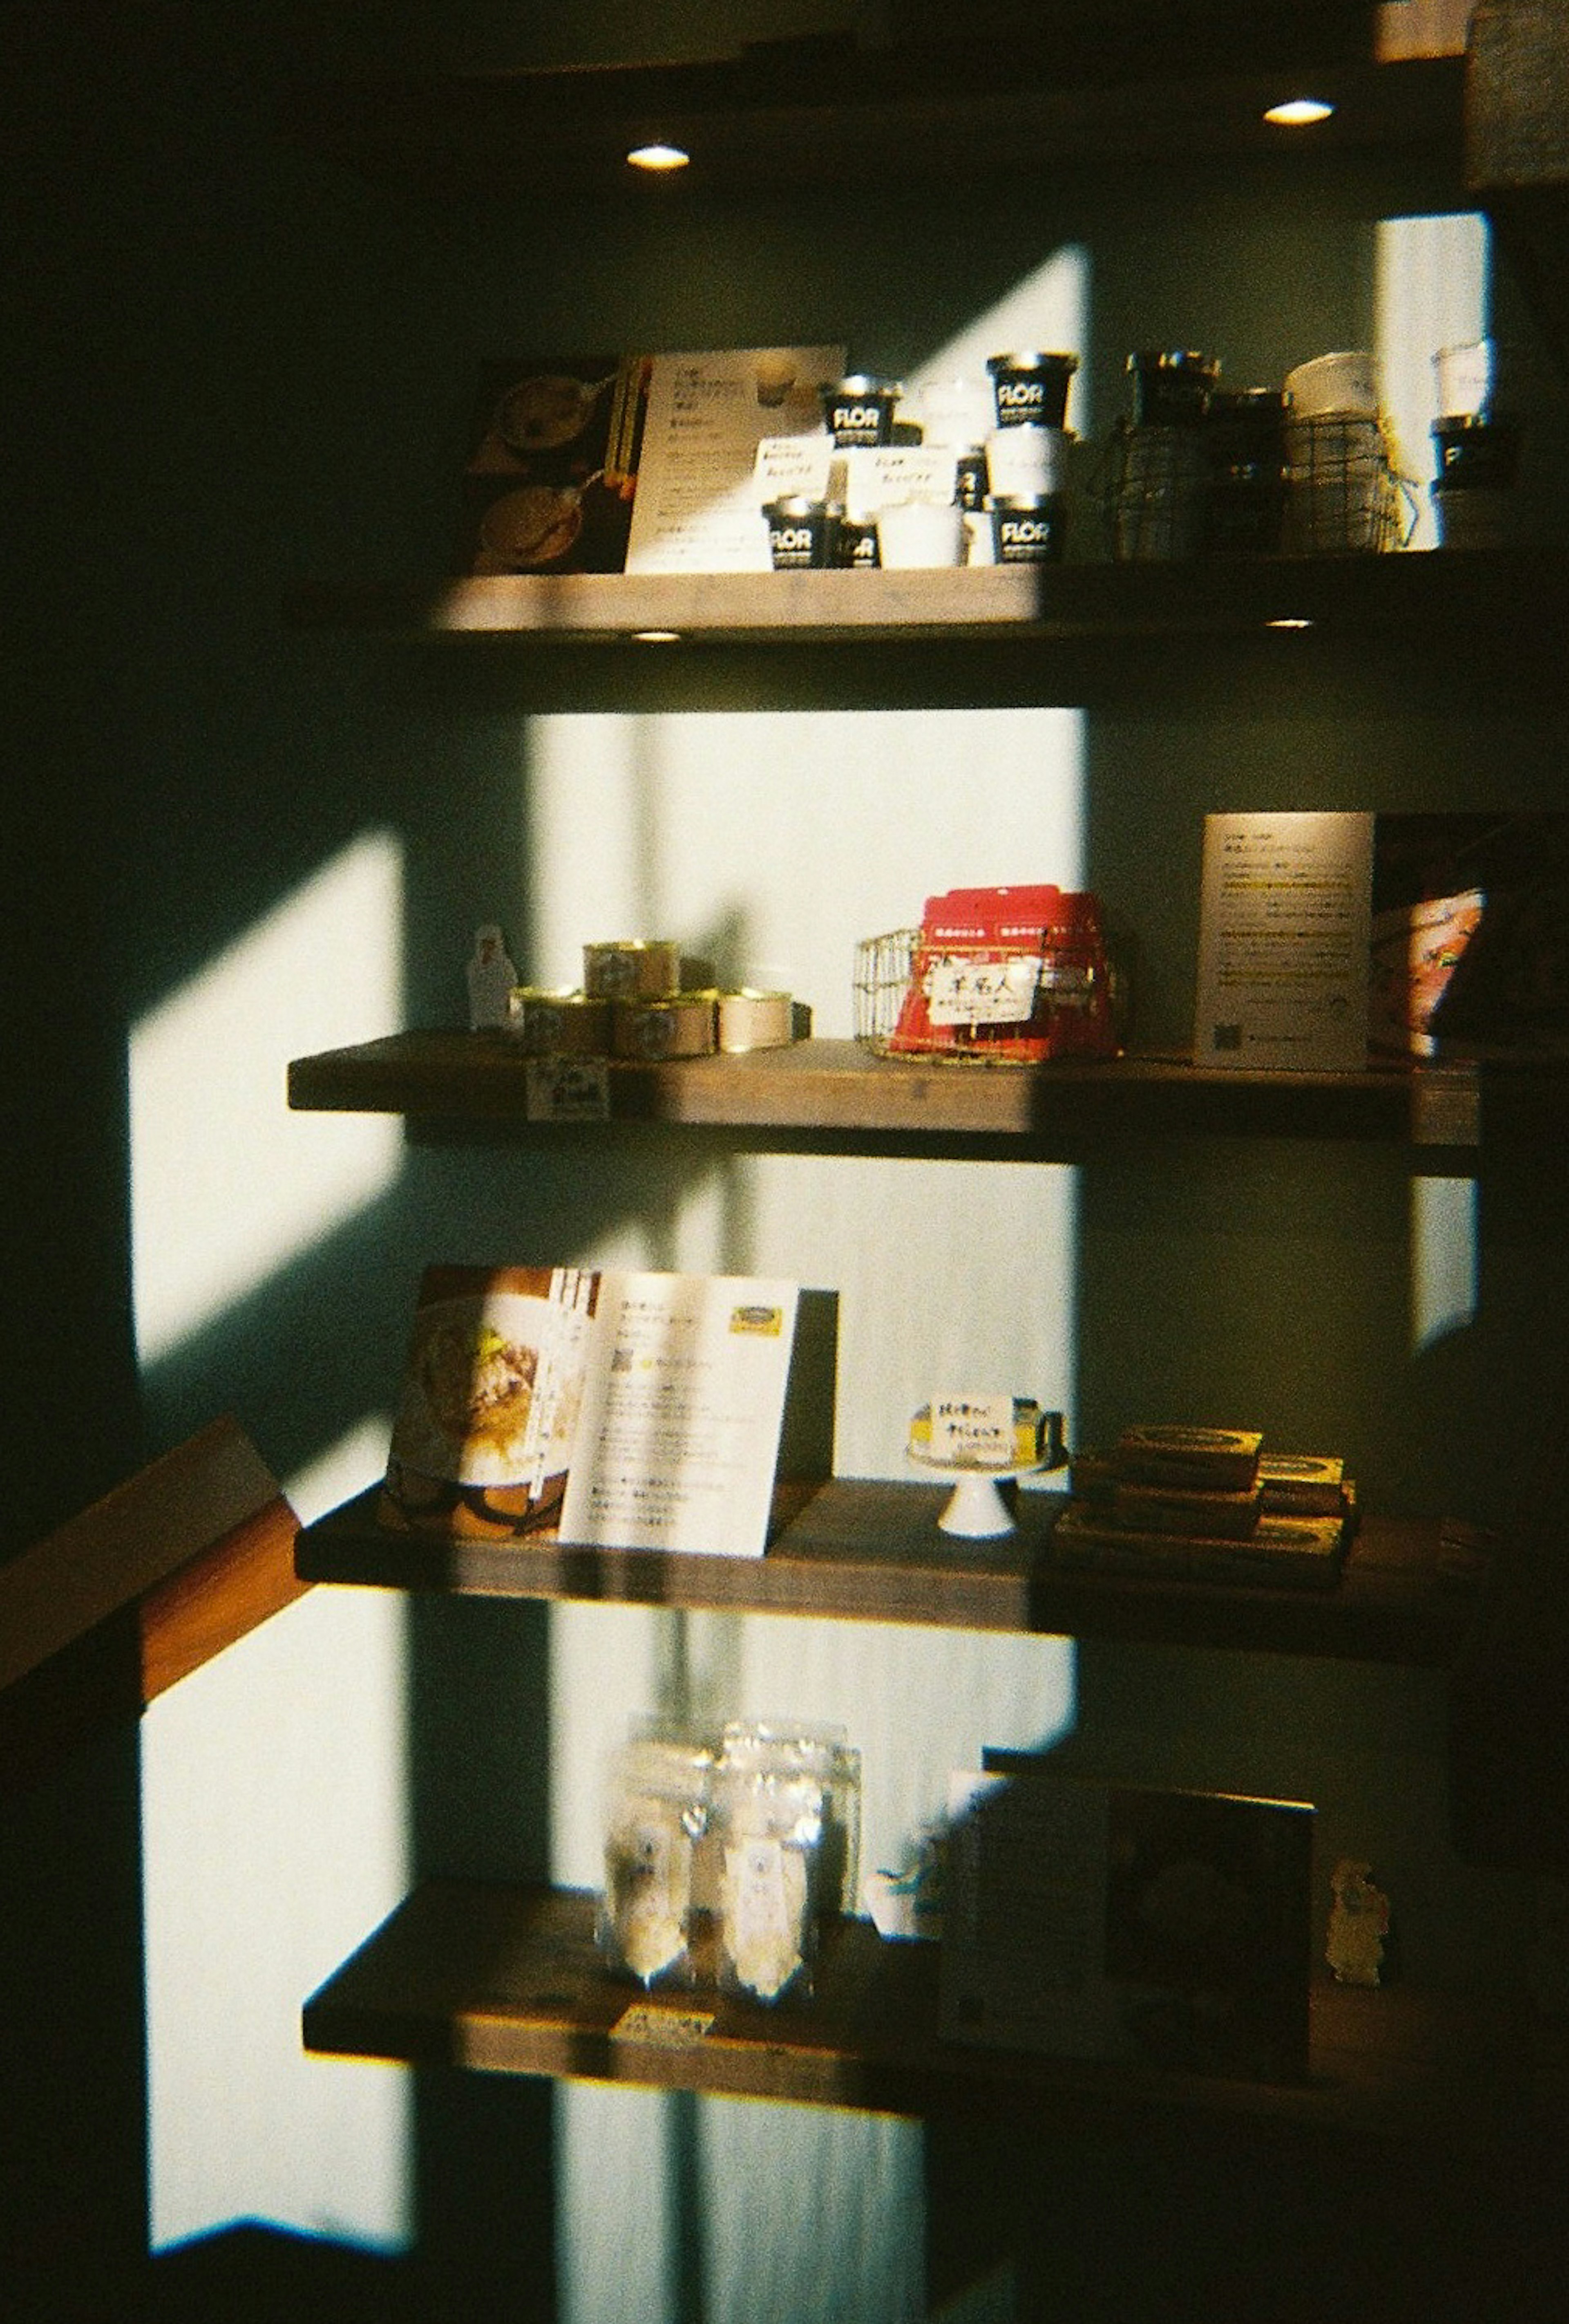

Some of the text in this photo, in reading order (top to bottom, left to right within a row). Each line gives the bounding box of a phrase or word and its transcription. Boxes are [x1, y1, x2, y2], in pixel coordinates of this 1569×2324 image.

[998, 383, 1045, 405] FLOR
[834, 407, 880, 429] FLOR
[1001, 520, 1050, 543] FLOR
